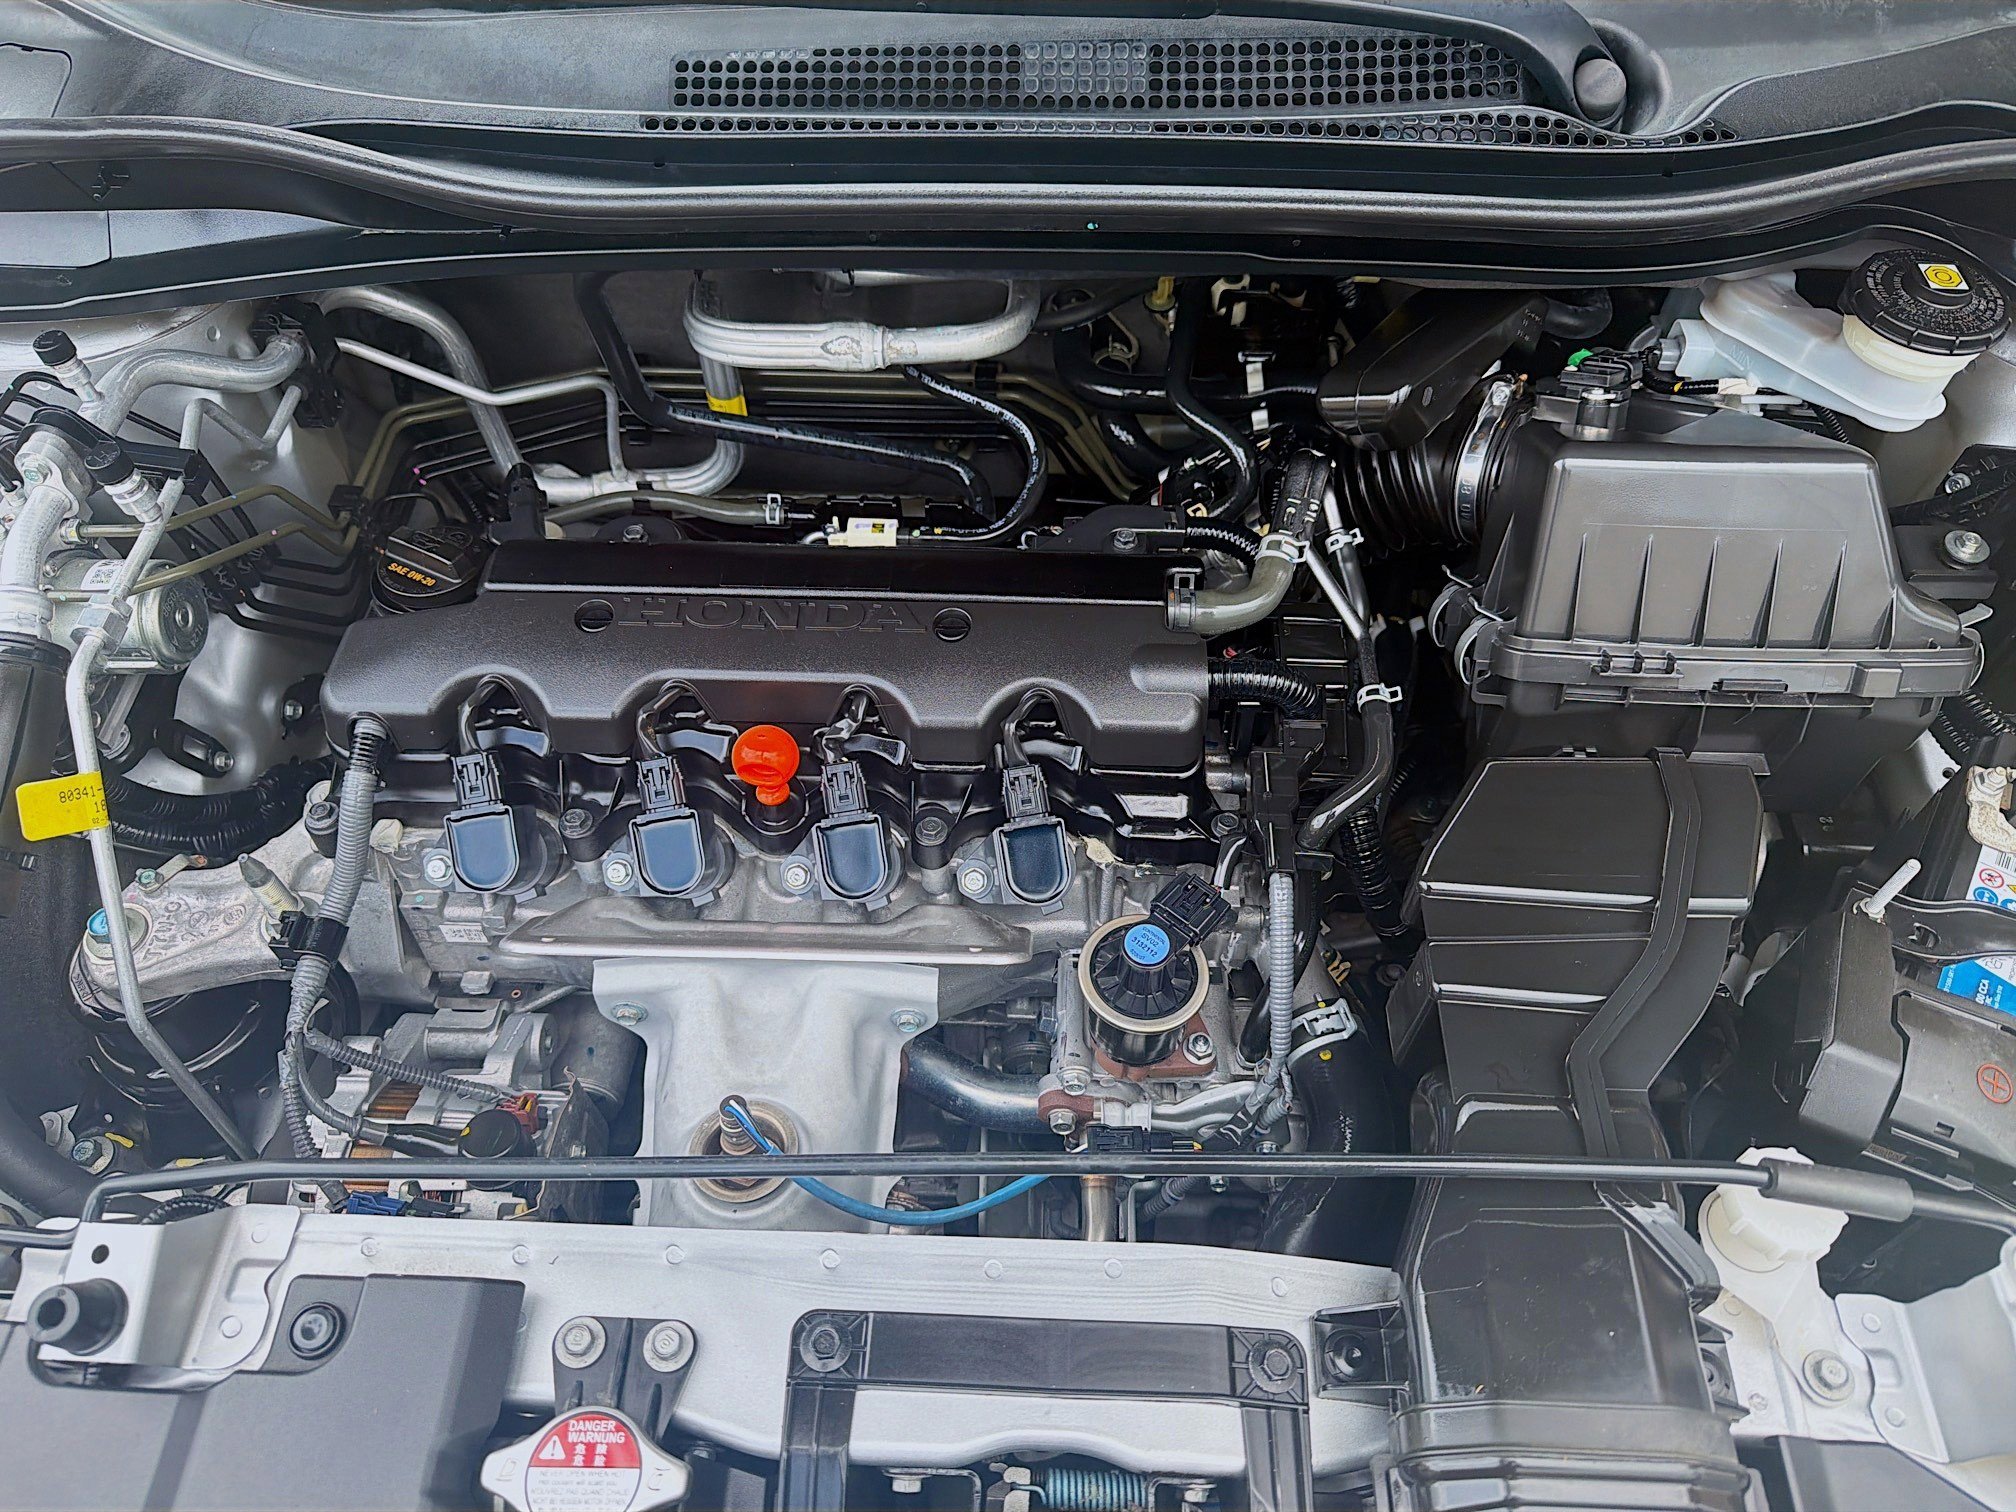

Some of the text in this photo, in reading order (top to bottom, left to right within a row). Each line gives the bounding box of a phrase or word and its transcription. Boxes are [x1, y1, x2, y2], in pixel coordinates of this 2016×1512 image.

[388, 562, 409, 576] SAE
[408, 570, 437, 587] 0W-20
[618, 597, 926, 632] HONDA
[1131, 936, 1158, 958] 3132112
[568, 1420, 616, 1431] DANGER
[568, 1431, 626, 1443] WARNUNG
